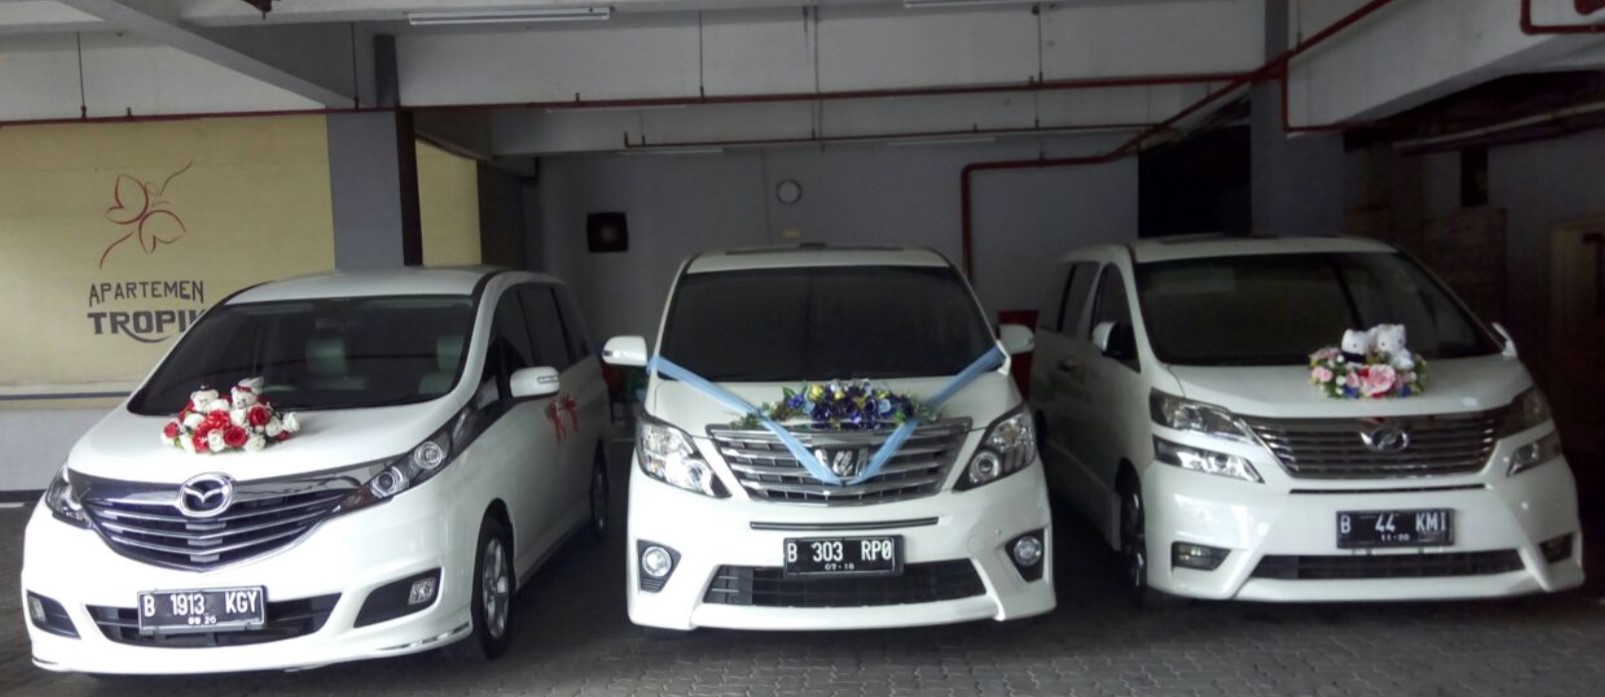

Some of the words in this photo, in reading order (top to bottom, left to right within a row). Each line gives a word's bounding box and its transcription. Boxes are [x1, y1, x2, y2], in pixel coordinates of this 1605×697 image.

[88, 280, 204, 308] APARTEMEN
[1341, 514, 1351, 534] B
[1375, 513, 1396, 533] 44
[1416, 511, 1447, 532] KMI
[787, 542, 798, 563] B
[810, 541, 844, 562] 303
[143, 594, 156, 617] B
[170, 593, 206, 616] 1913
[224, 590, 258, 614] KGY
